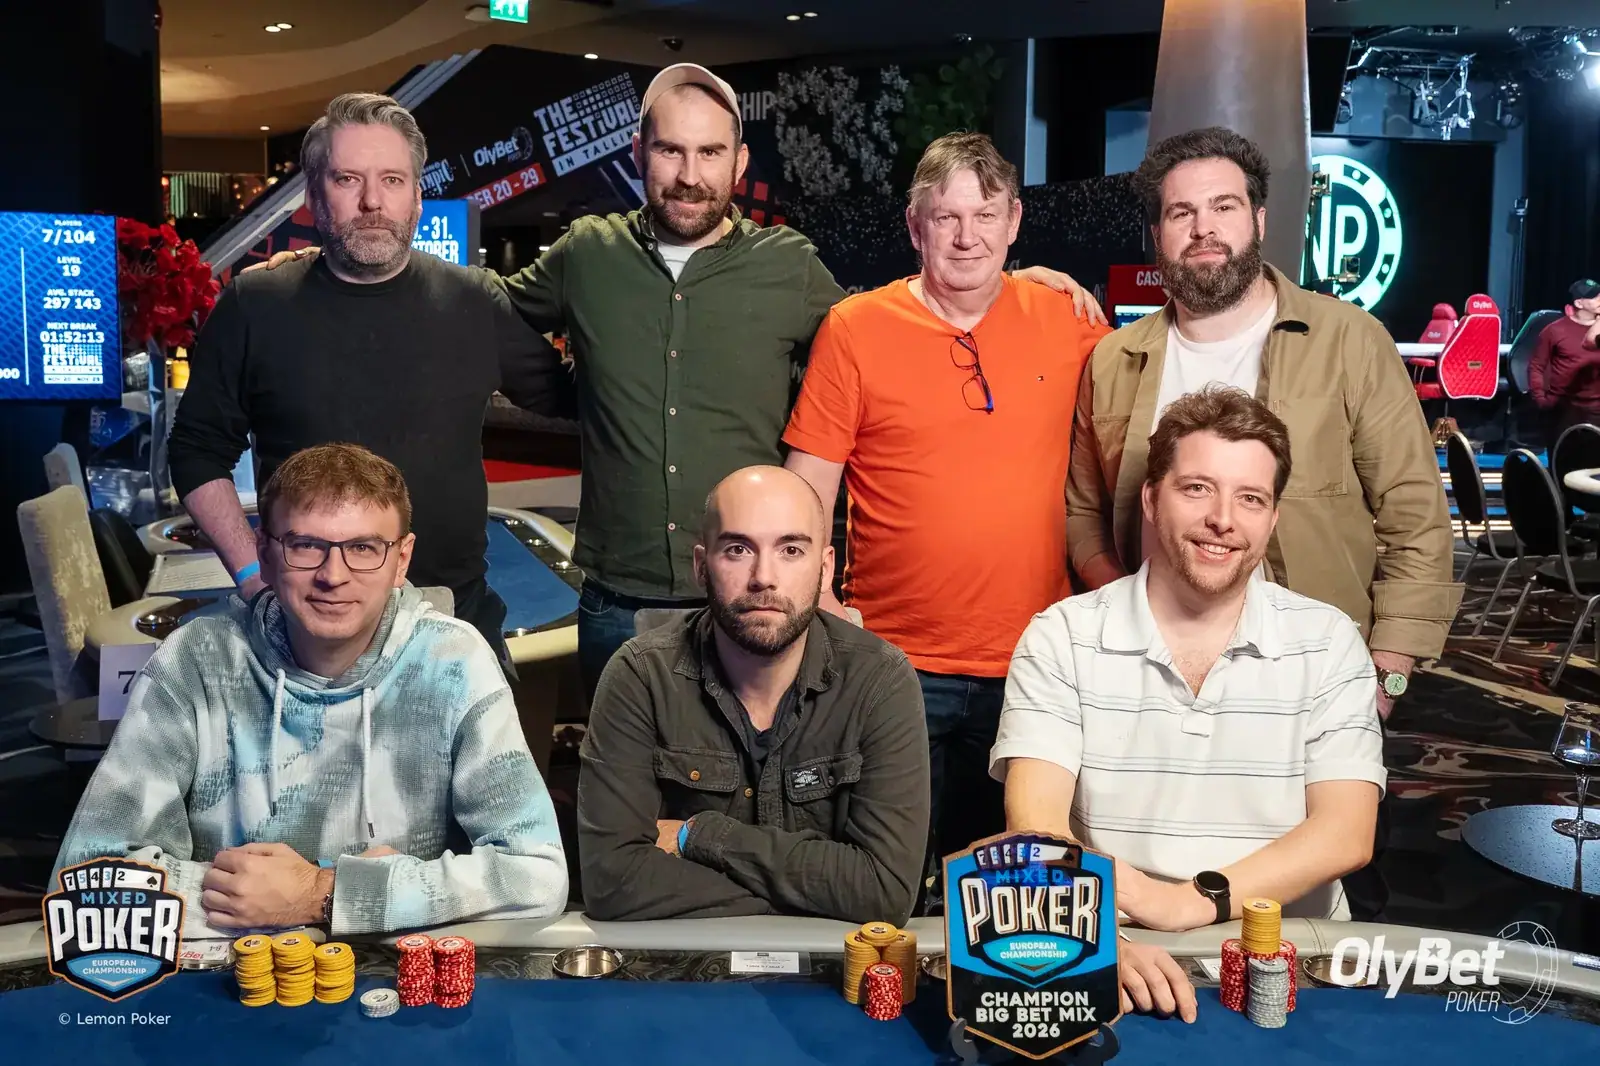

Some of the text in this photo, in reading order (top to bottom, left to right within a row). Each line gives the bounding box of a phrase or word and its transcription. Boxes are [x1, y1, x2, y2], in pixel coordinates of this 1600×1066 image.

[737, 91, 777, 121] HIP
[534, 97, 578, 132] THE
[473, 137, 519, 166] OlyBet
[558, 125, 641, 171] IN TALLIN
[493, 180, 513, 201] 20
[520, 167, 540, 189] 29
[42, 229, 96, 246] 7/104
[57, 256, 82, 264] LEVEL
[62, 264, 81, 277] 19
[43, 297, 102, 310] 297 143
[47, 322, 97, 330] NEXT BREAK
[40, 331, 105, 343] 01:52:13
[43, 344, 67, 355] THE
[1032, 846, 1041, 857] 2
[995, 869, 1064, 884] MIXED
[961, 877, 1101, 947] POKER
[1009, 942, 1057, 950] EUROPEAN
[1000, 950, 1068, 959] CHAMPIONSHIP
[980, 991, 1089, 1007] CHAMPION
[975, 1007, 1097, 1023] BIG BET MIX
[1011, 1022, 1061, 1039] 2026
